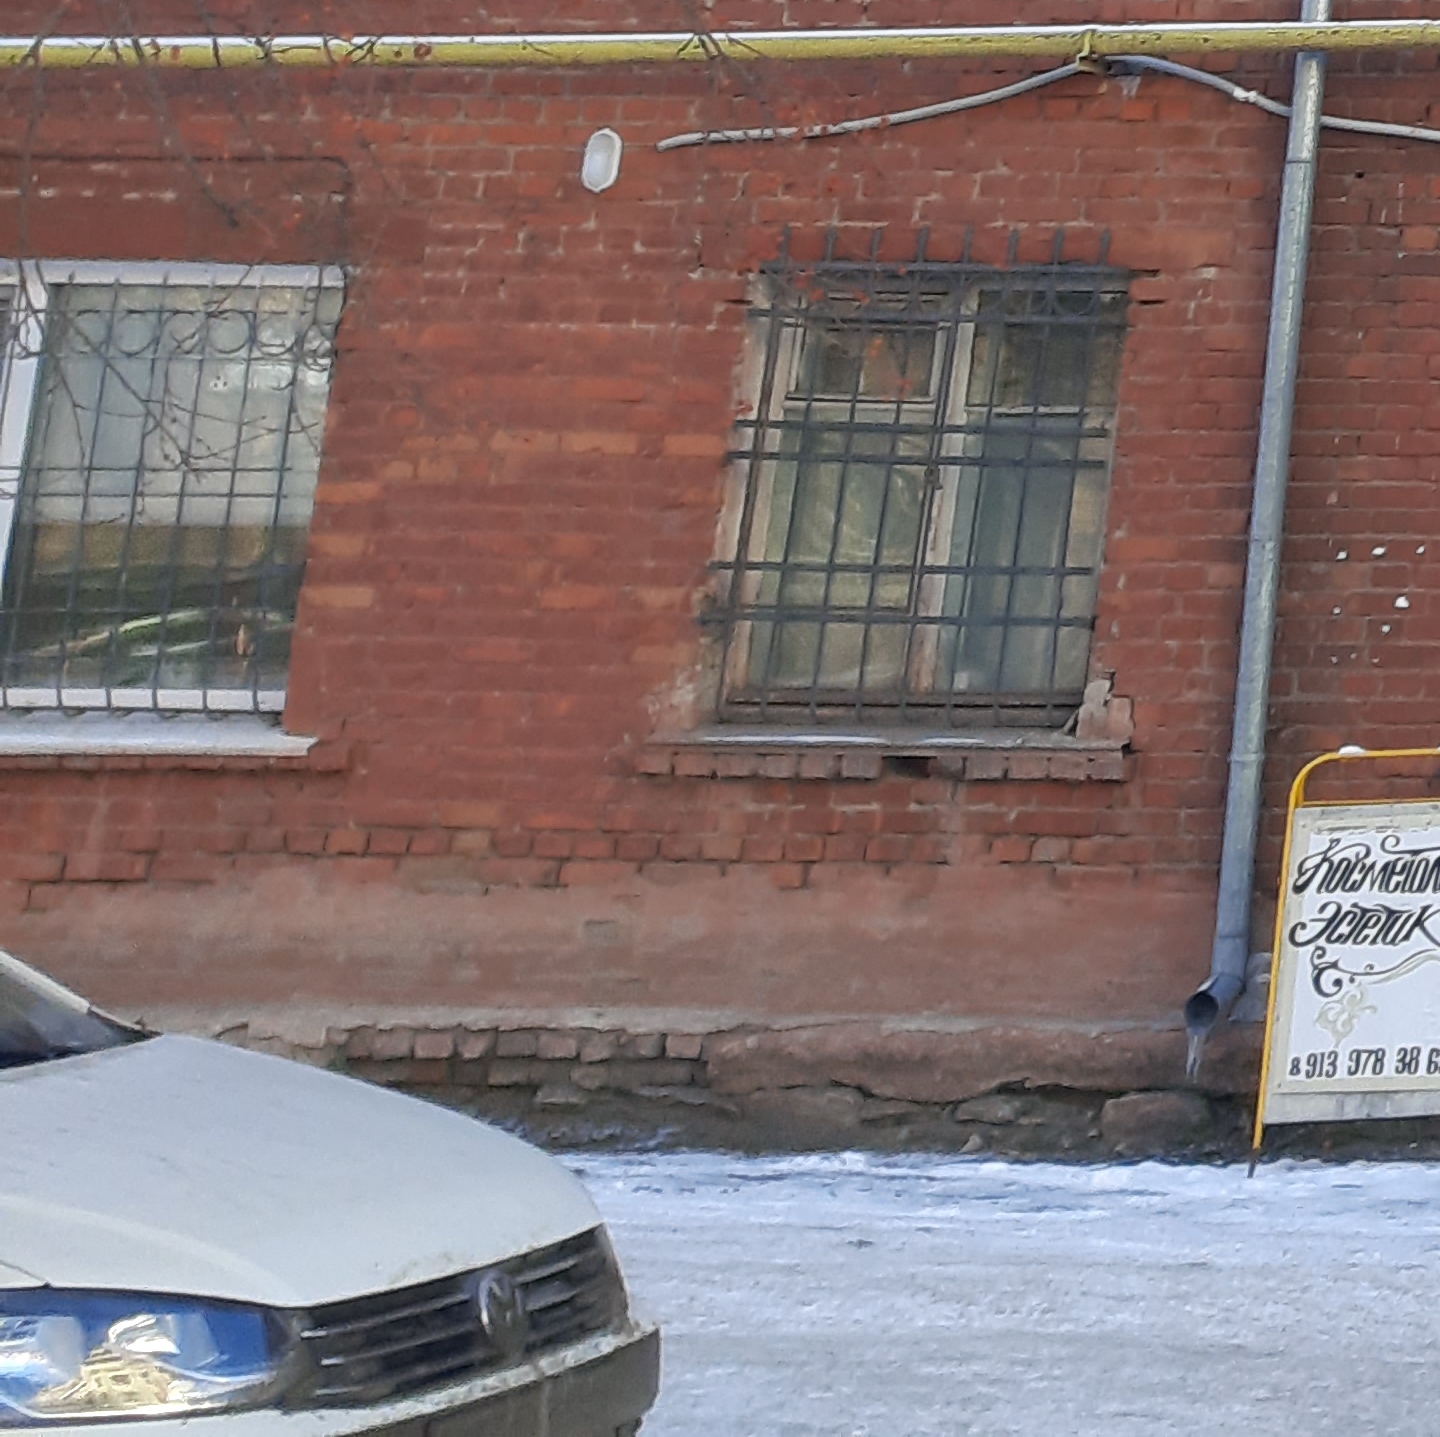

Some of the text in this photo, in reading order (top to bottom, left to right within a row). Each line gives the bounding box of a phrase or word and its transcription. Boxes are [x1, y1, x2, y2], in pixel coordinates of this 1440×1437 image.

[1288, 1058, 1302, 1077] 8
[1304, 1047, 1339, 1079] 913
[1346, 1046, 1387, 1077] 978
[1394, 1045, 1420, 1075] 38
